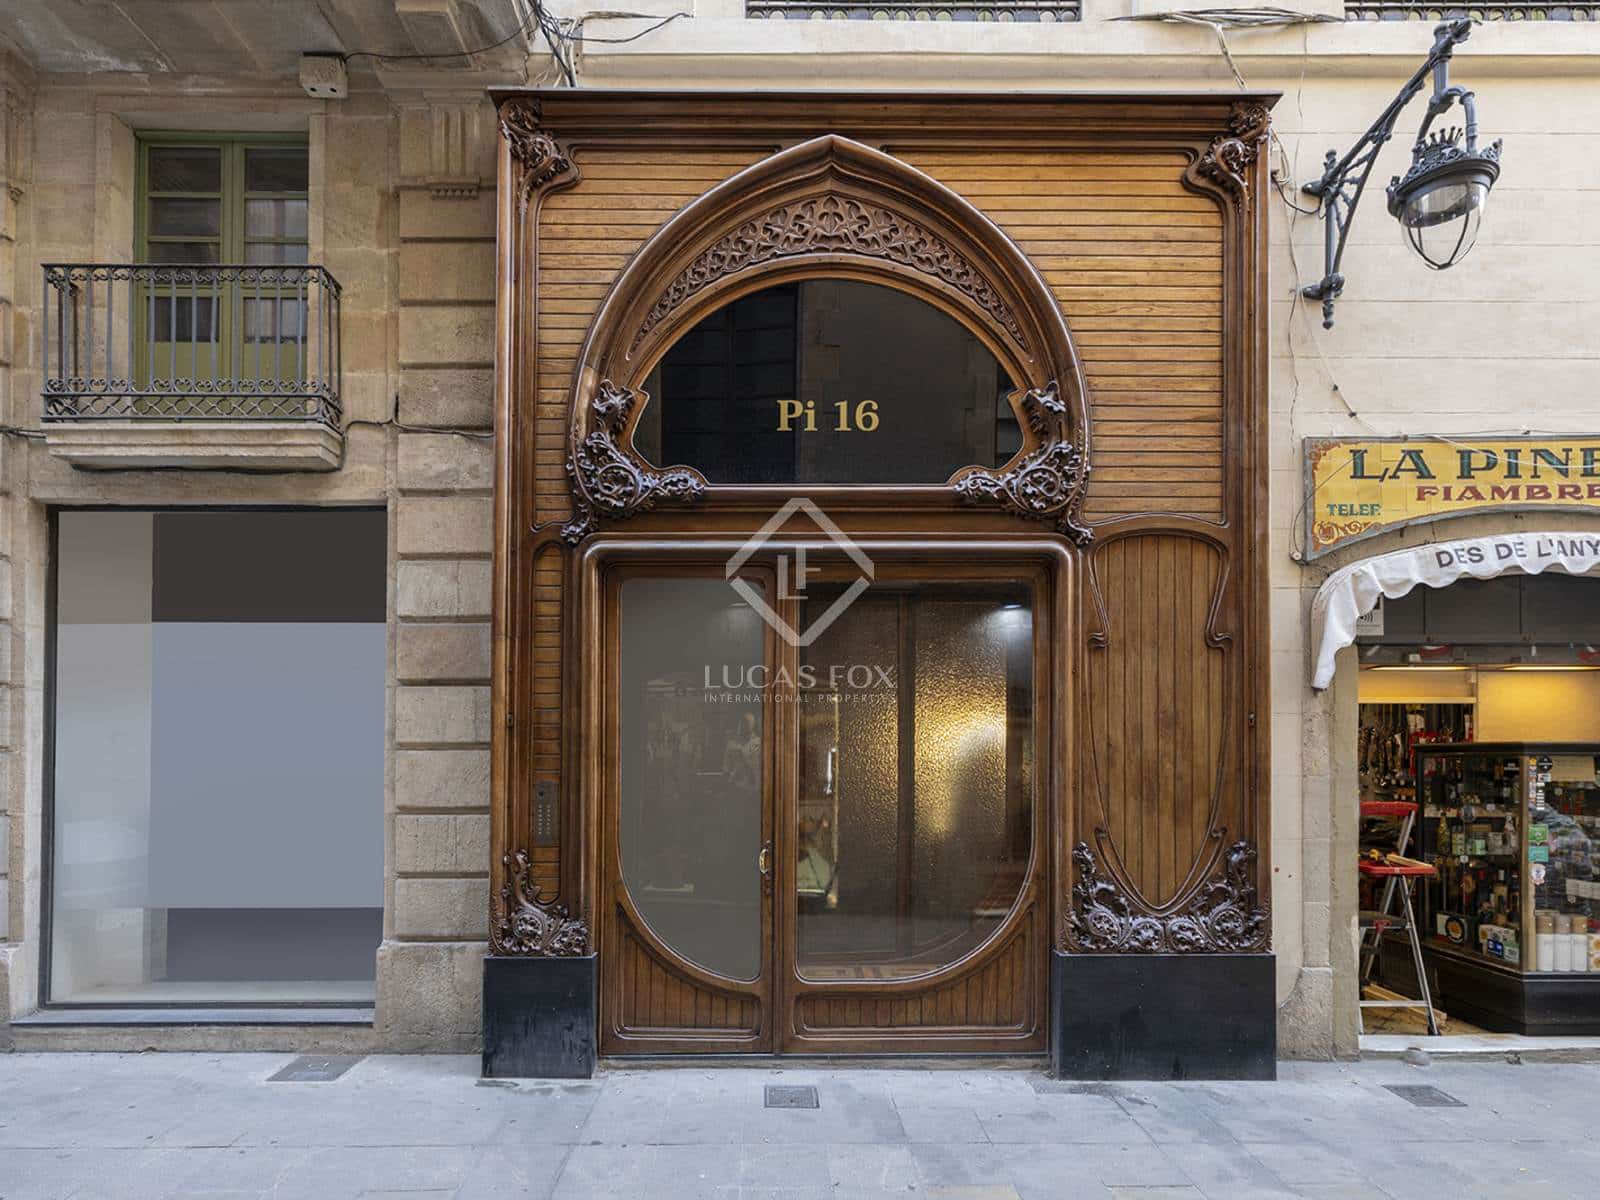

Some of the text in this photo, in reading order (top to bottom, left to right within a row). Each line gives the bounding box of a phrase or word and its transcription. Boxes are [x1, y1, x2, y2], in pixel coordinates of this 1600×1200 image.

[777, 399, 880, 431] Pi 16
[1350, 447, 1600, 482] LA PINE
[1416, 484, 1600, 501] FIAMBRE
[1327, 503, 1381, 516] TELEF.
[1435, 546, 1485, 568] DES
[1495, 541, 1527, 560] DE
